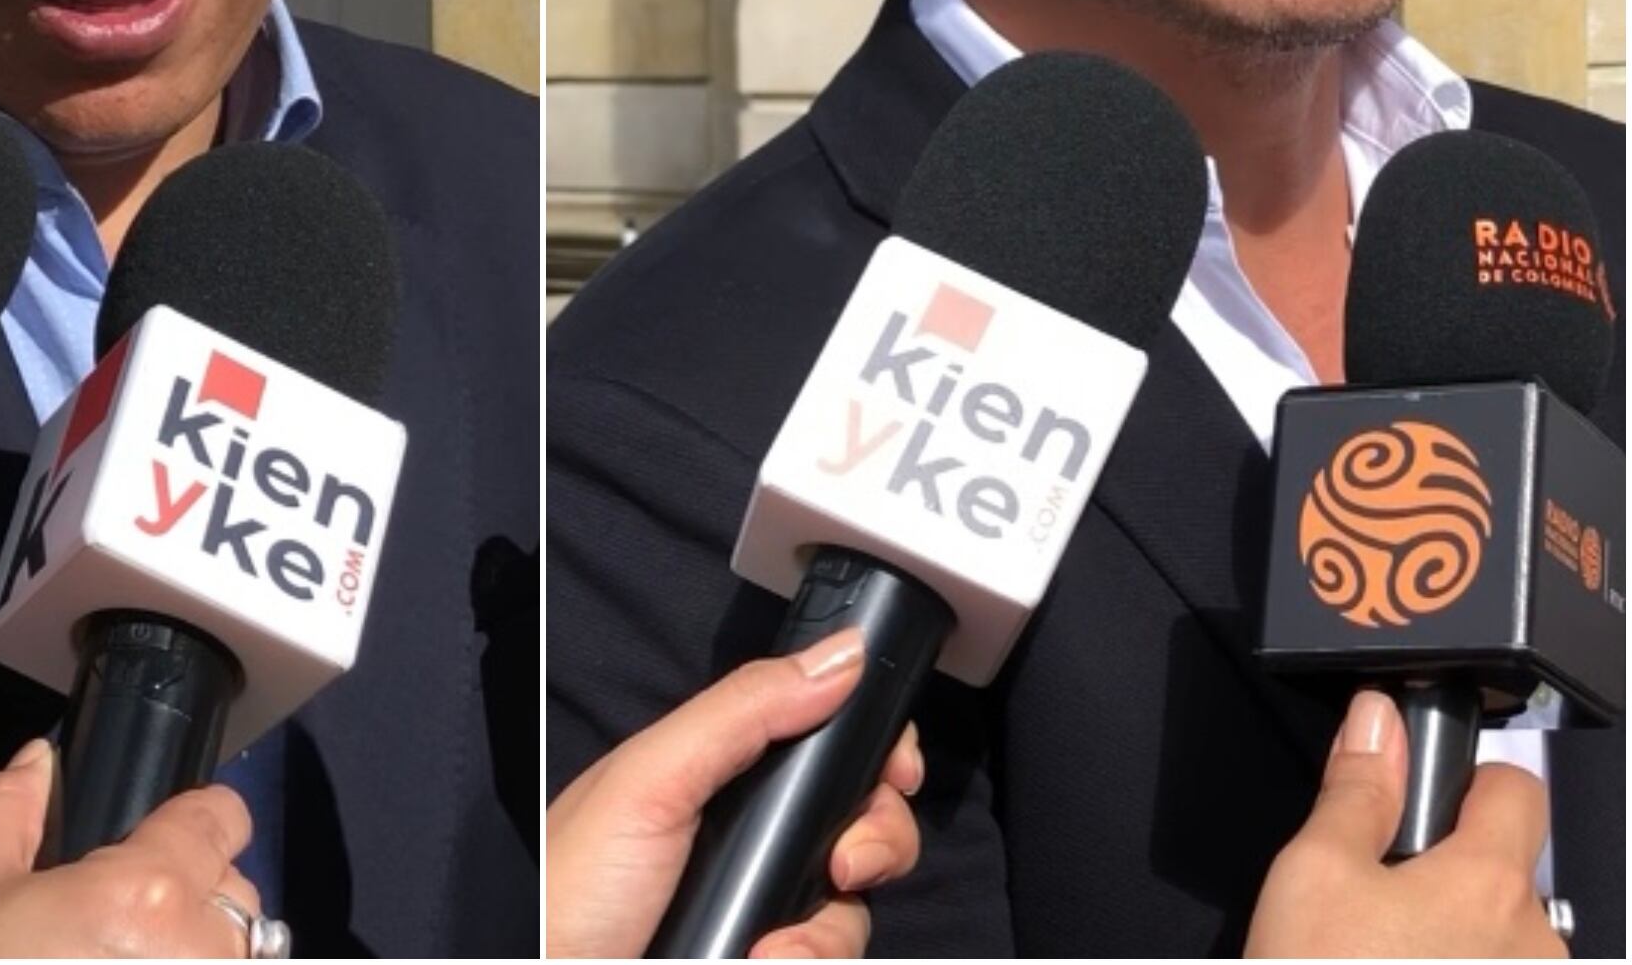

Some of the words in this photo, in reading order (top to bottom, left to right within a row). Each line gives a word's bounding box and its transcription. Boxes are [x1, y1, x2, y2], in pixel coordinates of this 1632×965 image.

[1475, 218, 1591, 265] RADIO
[1478, 250, 1595, 286] NACIONAL
[1478, 269, 1504, 283] DE
[156, 375, 377, 548] kien
[858, 309, 1093, 483] kien
[134, 459, 326, 602] yke
[815, 398, 1021, 540] yke
